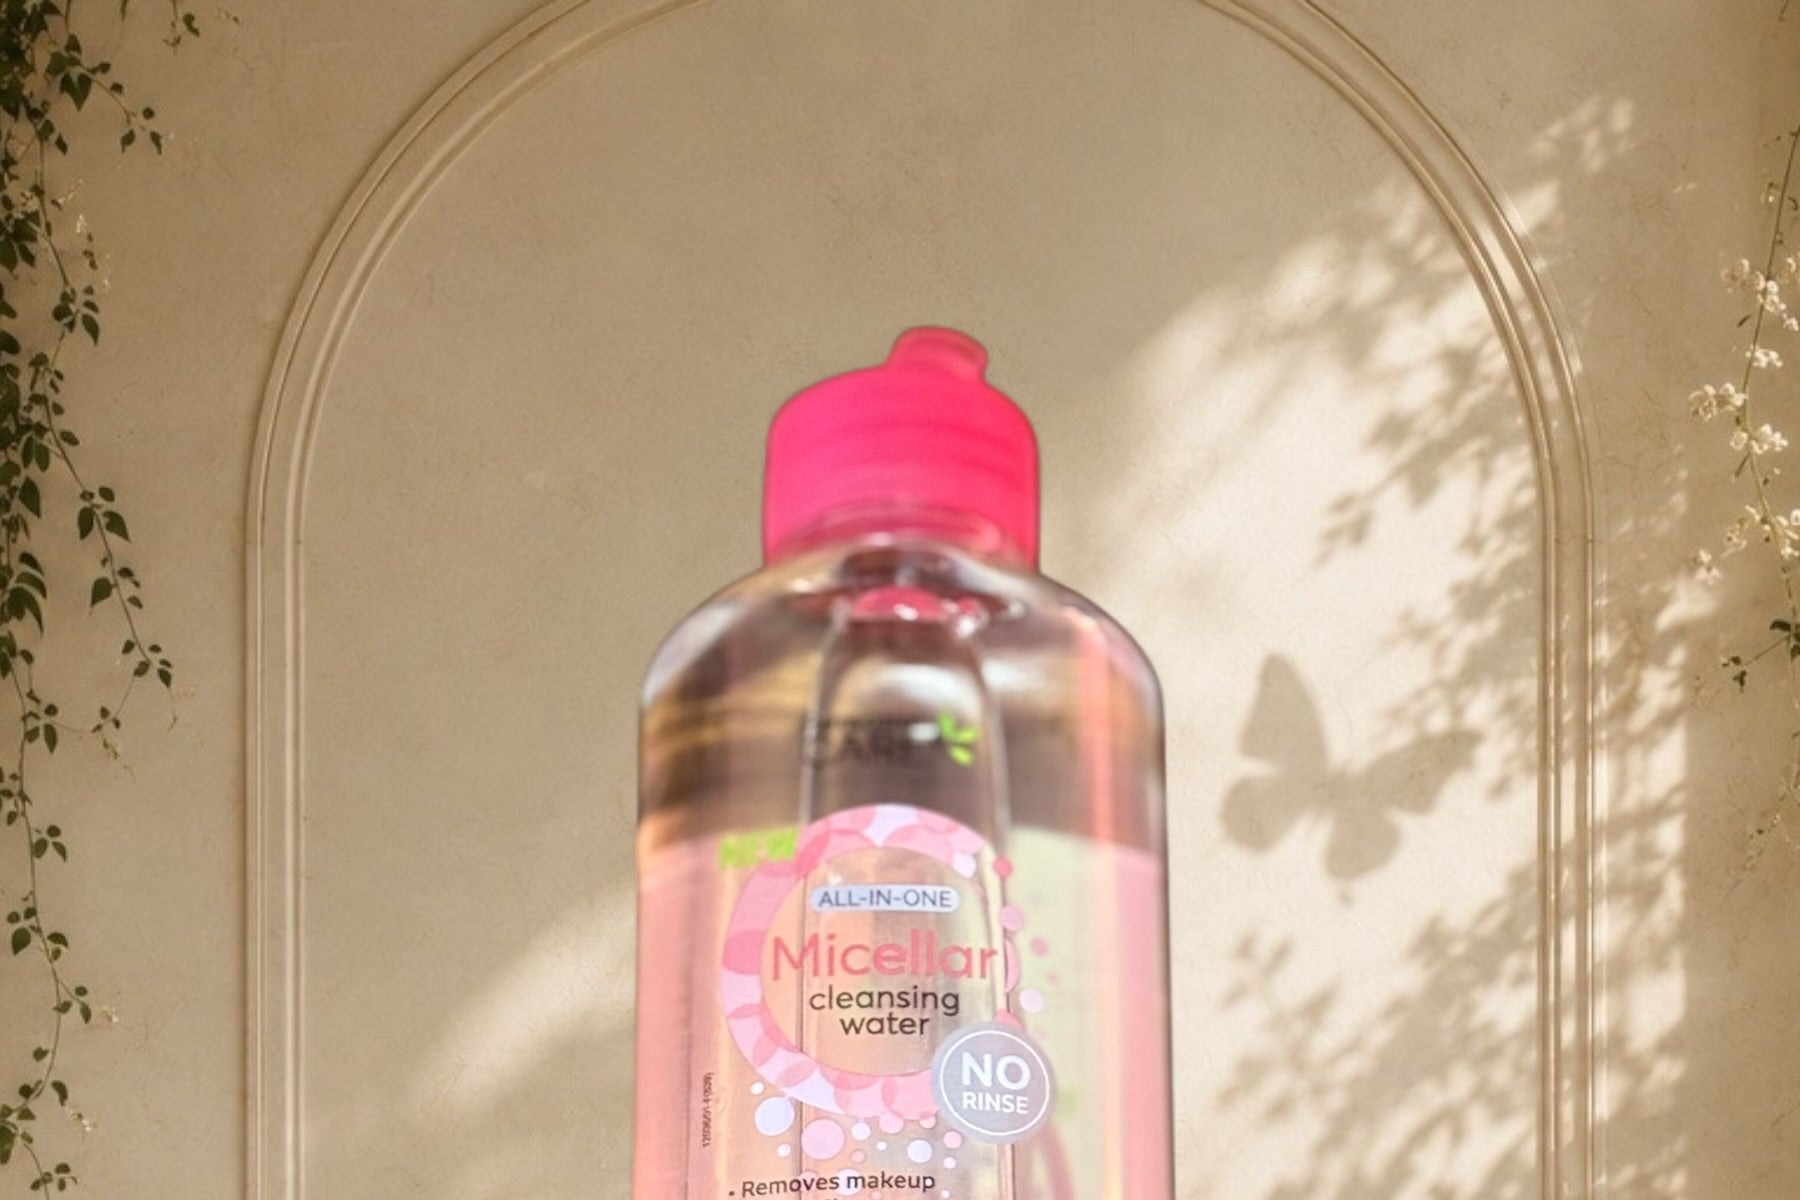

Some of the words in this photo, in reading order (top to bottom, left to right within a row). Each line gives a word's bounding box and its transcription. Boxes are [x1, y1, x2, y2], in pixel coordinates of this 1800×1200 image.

[817, 888, 953, 908] ALL-IN-ONE
[772, 929, 998, 981] Micellar
[809, 985, 960, 1016] cleansing
[839, 1014, 931, 1036] water
[961, 1052, 1031, 1090] NO
[962, 1092, 1030, 1115] RINSE
[741, 1175, 840, 1198] Removes
[846, 1171, 936, 1193] makeup
